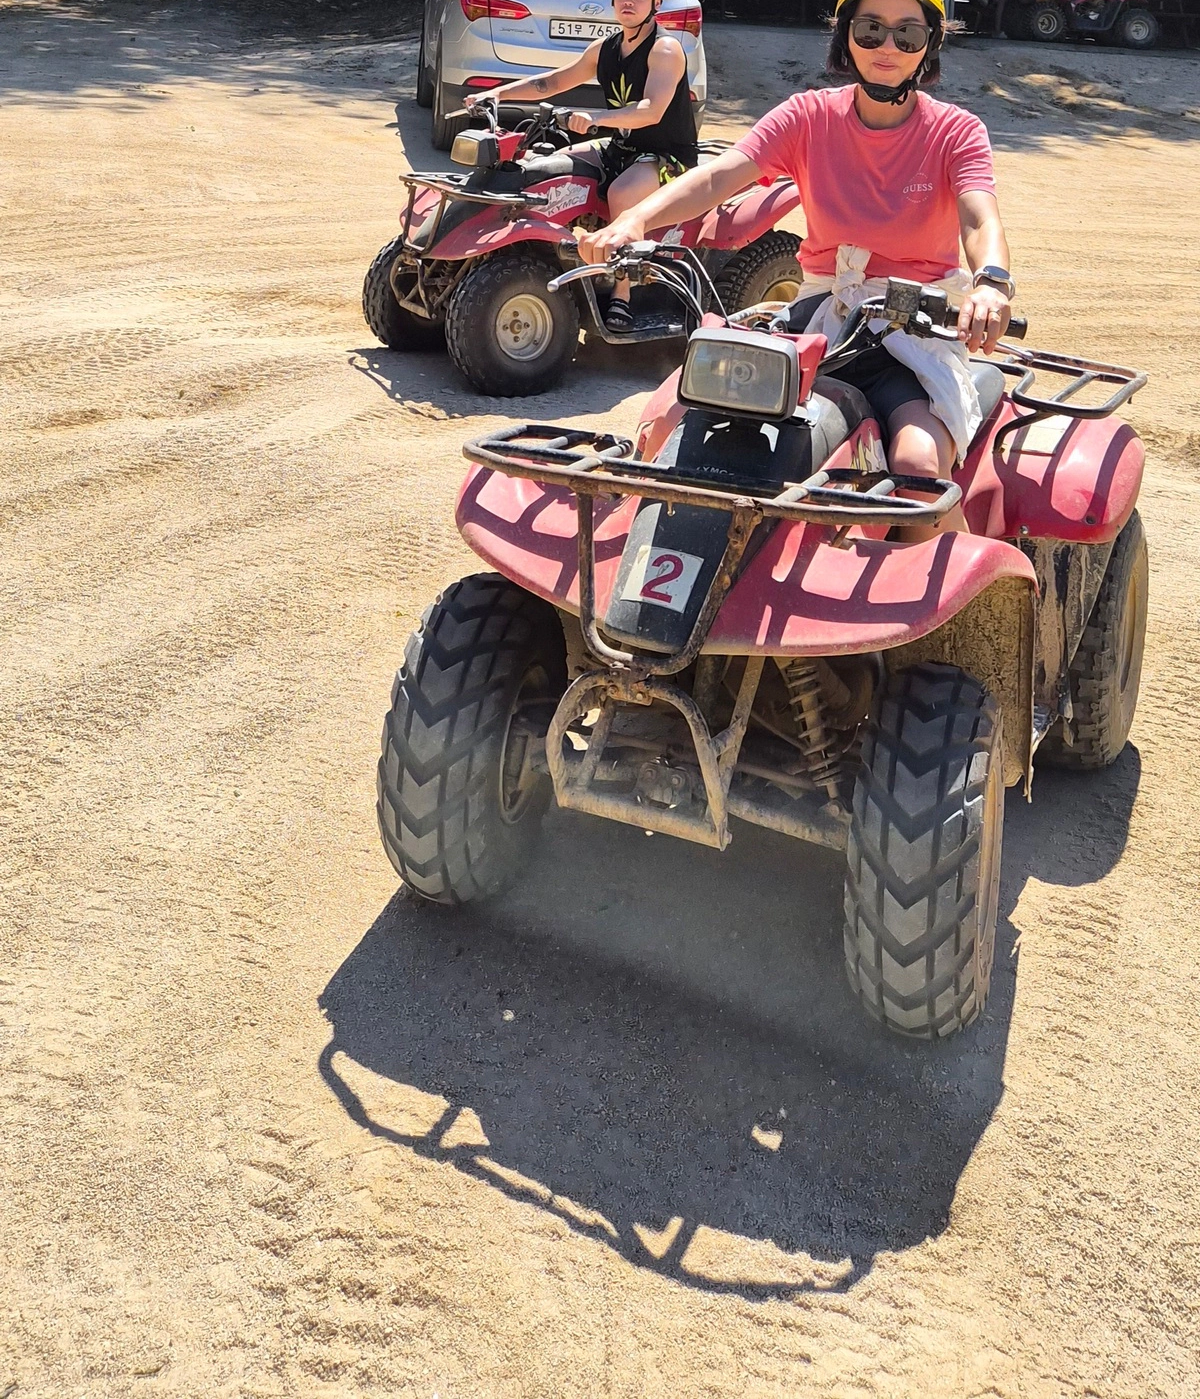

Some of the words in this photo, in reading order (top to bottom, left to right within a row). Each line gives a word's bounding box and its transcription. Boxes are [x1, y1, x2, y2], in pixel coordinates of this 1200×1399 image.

[558, 23, 582, 35] 51무
[902, 182, 934, 194] GUESS
[548, 194, 587, 216] KYMCO
[639, 554, 684, 604] 2
